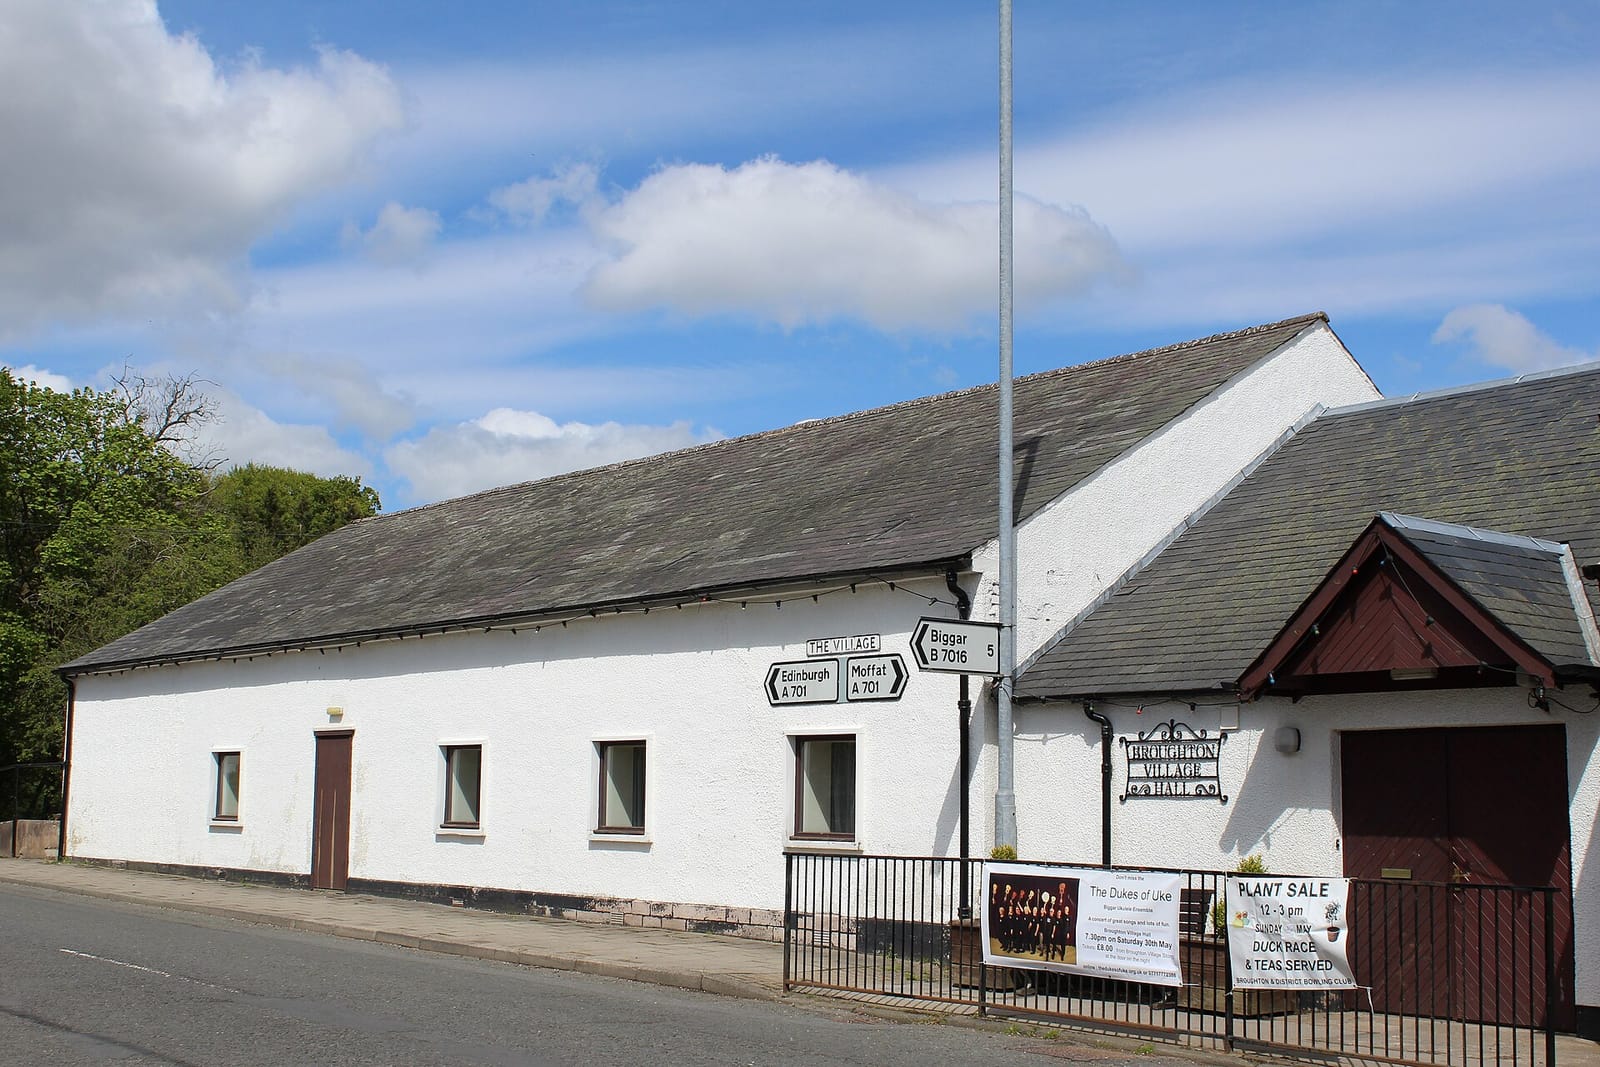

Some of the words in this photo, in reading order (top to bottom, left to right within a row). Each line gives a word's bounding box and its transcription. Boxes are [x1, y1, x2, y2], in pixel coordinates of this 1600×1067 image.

[931, 629, 968, 646] Biggar
[810, 640, 830, 653] THE
[832, 637, 877, 652] VILLAGE
[987, 644, 994, 657] 5
[930, 650, 938, 662] B
[941, 650, 968, 663] 7016
[781, 668, 830, 683] Edinburgh
[851, 664, 887, 678] Moffat
[782, 686, 790, 697] A
[791, 685, 807, 697] 701
[851, 682, 860, 694] A
[862, 680, 879, 694] 701
[1132, 743, 1215, 759] BROUGHTON
[1144, 763, 1202, 777] VILLAGE
[1154, 782, 1190, 796] HALL
[1090, 885, 1107, 898] The
[1109, 887, 1139, 900] Dukes
[1140, 889, 1151, 901] of
[1152, 890, 1172, 902] Uke
[1238, 882, 1283, 898] PLANT
[1286, 882, 1330, 898] SALE
[1260, 904, 1270, 916] 12
[1279, 904, 1285, 916] 3
[1287, 906, 1303, 918] pm
[1127, 929, 1142, 937] Village
[1255, 924, 1283, 934] SUNDAY
[1296, 924, 1312, 934] MAY
[1085, 932, 1107, 942] 7.30pm
[1117, 936, 1144, 948] Saturday
[1144, 939, 1158, 947] 30th
[1158, 941, 1173, 951] May
[1096, 943, 1113, 952] £8.00
[1253, 941, 1283, 953] DUCK
[1285, 941, 1317, 953] RACE
[1245, 959, 1252, 970] &
[1255, 959, 1282, 971] TEAS
[1285, 959, 1333, 971] SERVED
[1236, 977, 1269, 985] BROUGHTON
[1333, 977, 1353, 985] CLUB
